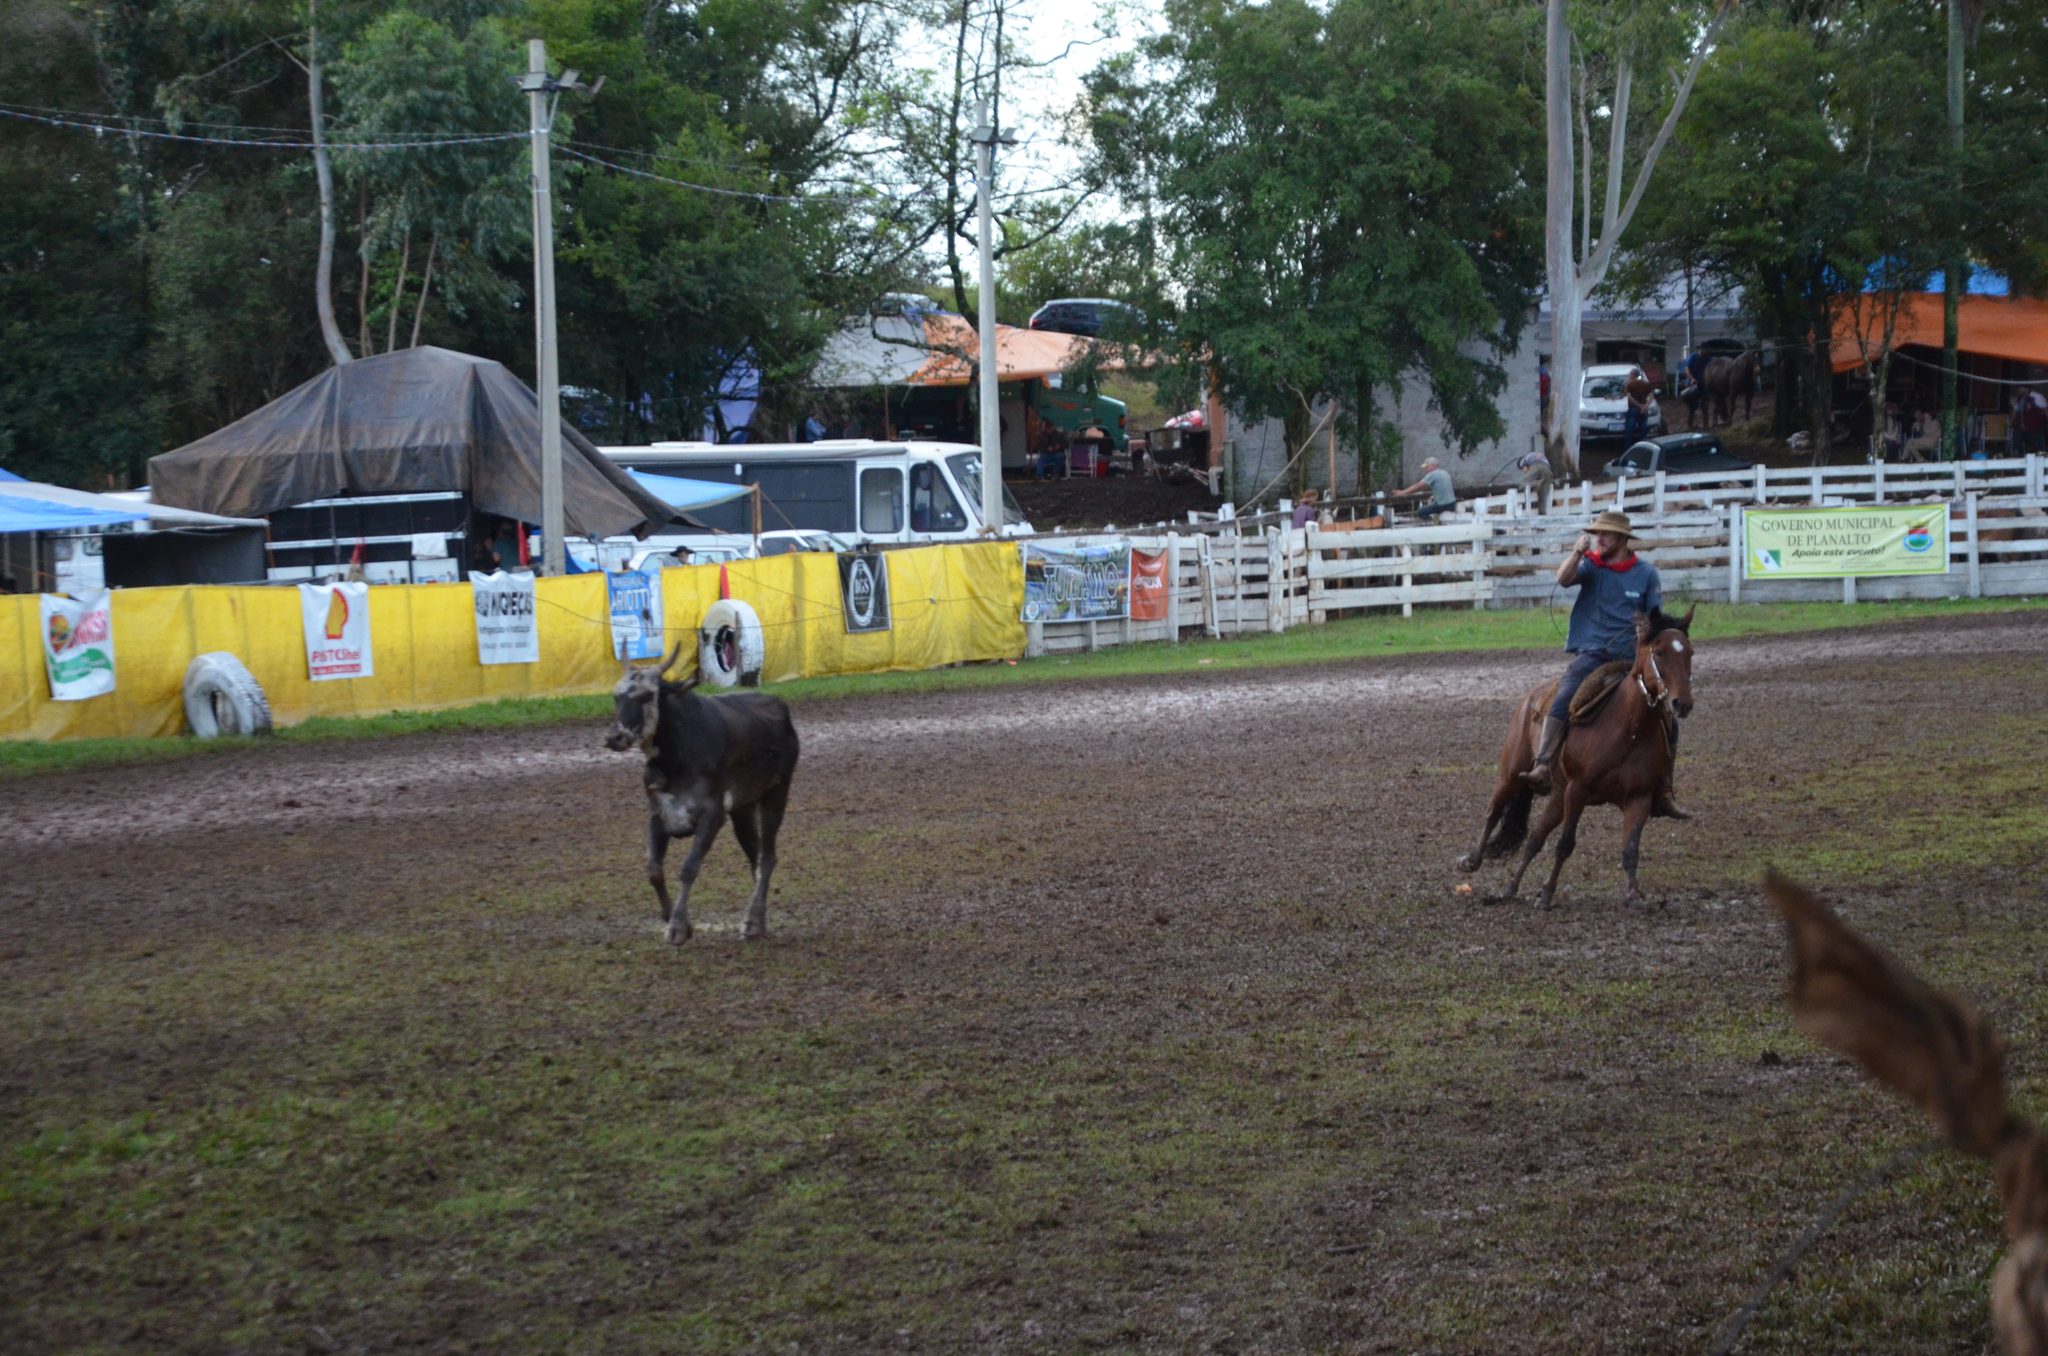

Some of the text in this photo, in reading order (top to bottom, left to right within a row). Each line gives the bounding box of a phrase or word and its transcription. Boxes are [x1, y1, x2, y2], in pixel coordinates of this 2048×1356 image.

[1762, 516, 1896, 532] GOVERNO MUNICIPAL
[1787, 533, 1872, 547] DE PLANALTO
[1792, 547, 1821, 558] Apoia
[1823, 548, 1845, 557] este
